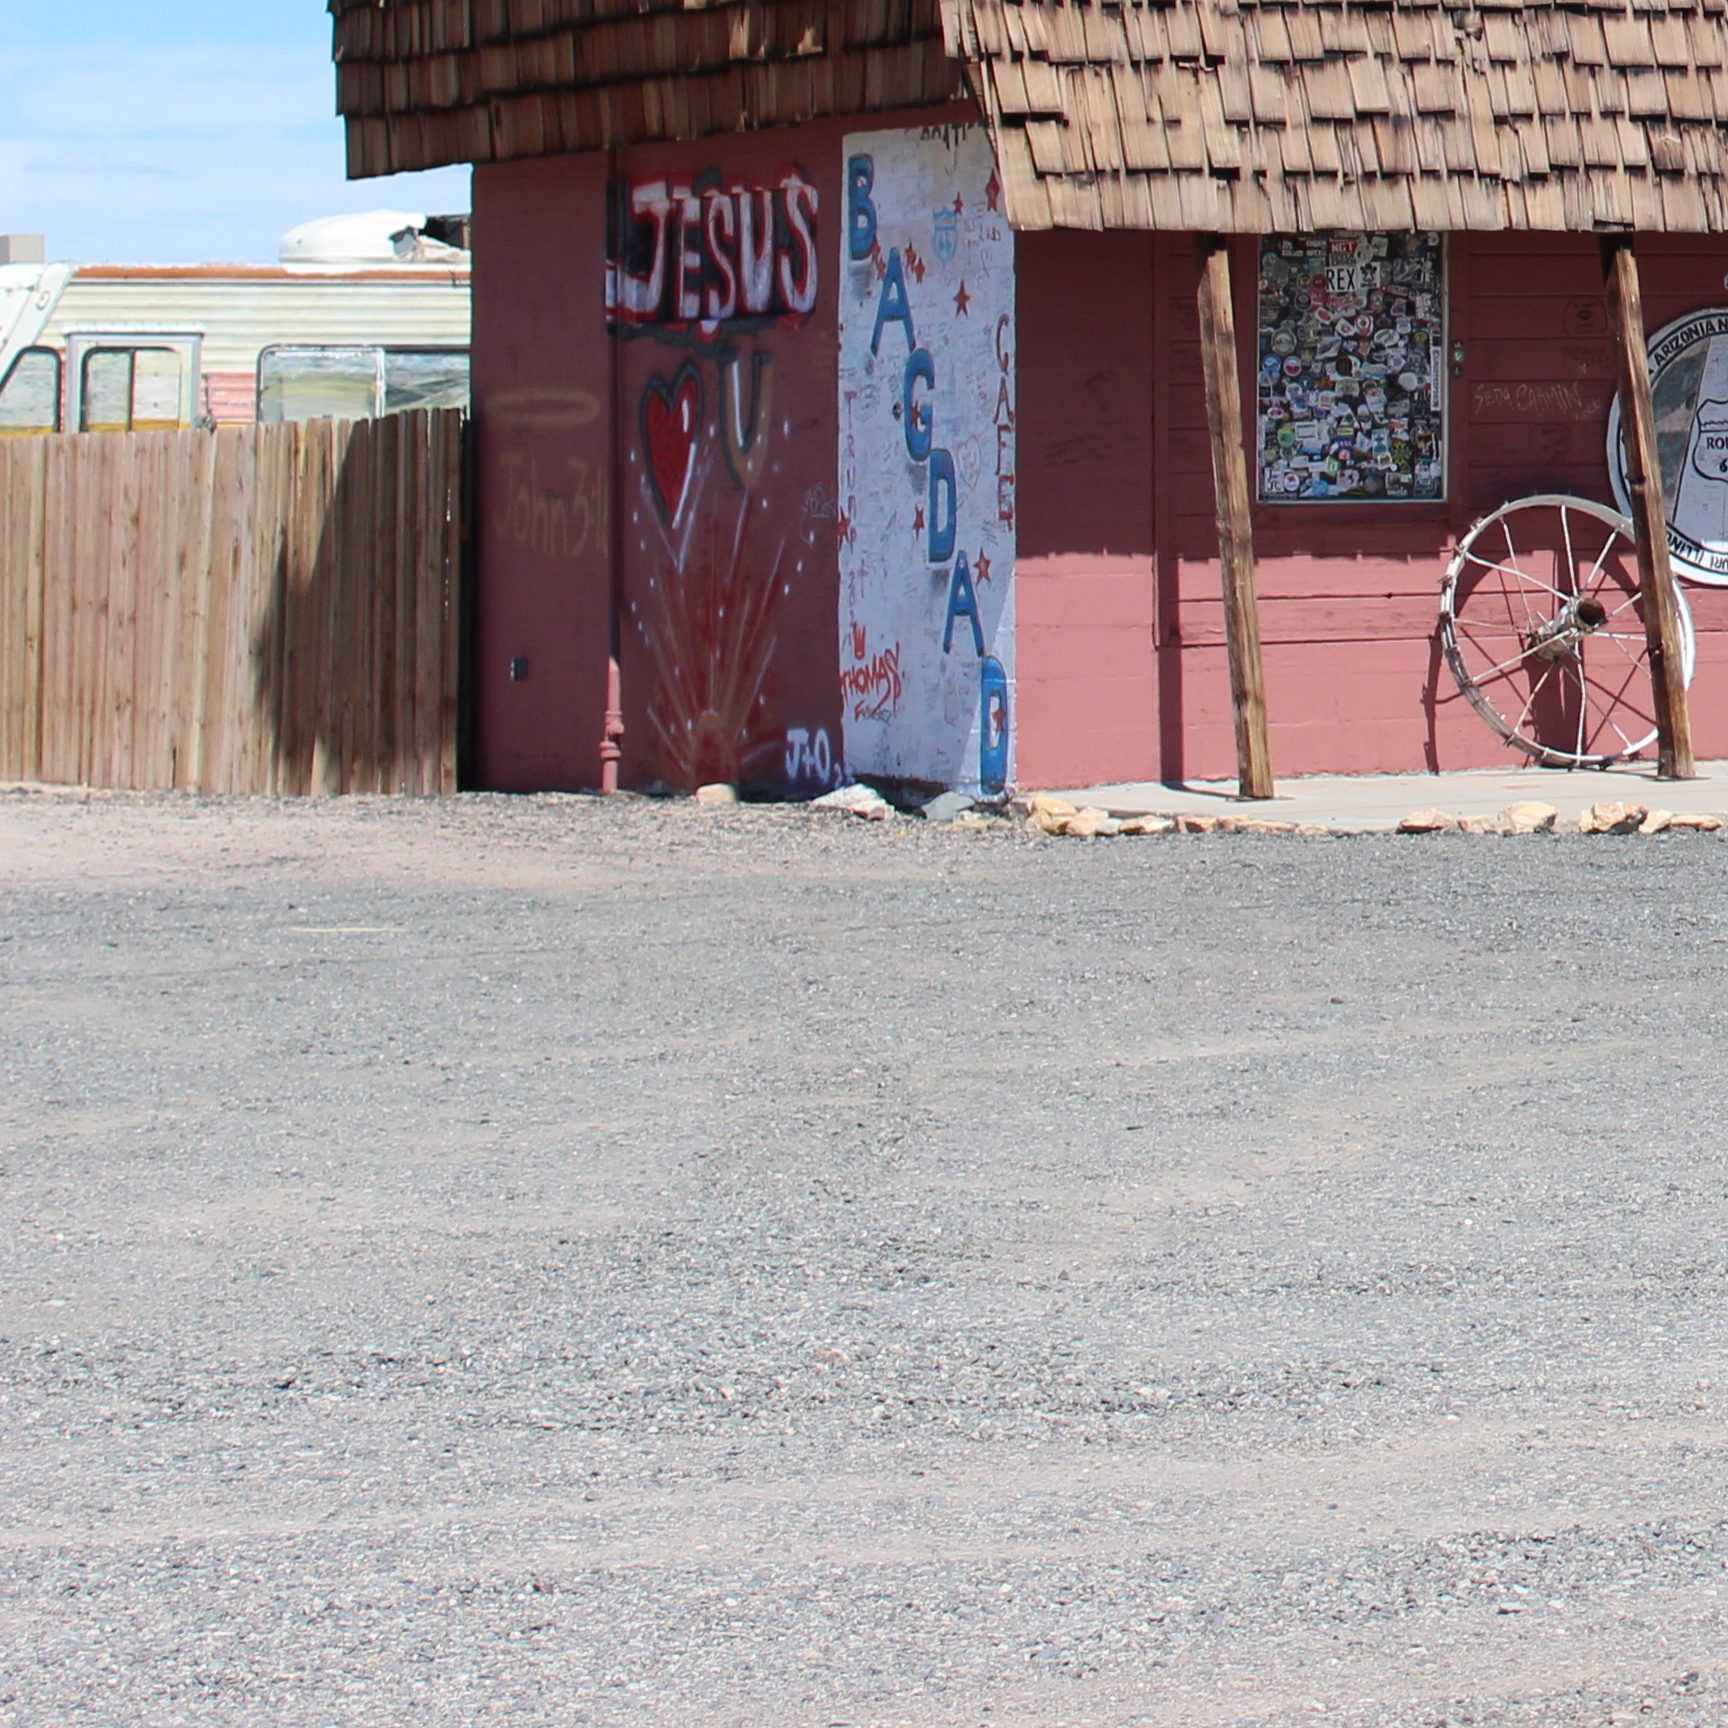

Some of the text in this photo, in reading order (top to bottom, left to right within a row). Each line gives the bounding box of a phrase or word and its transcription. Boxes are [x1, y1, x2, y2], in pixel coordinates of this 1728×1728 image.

[608, 172, 820, 320] JESUS
[1325, 268, 1355, 291] REX
[1653, 318, 1716, 366] ARIZONIA
[848, 153, 1009, 796] BAGDAD
[1666, 530, 1705, 564] ILLIN
